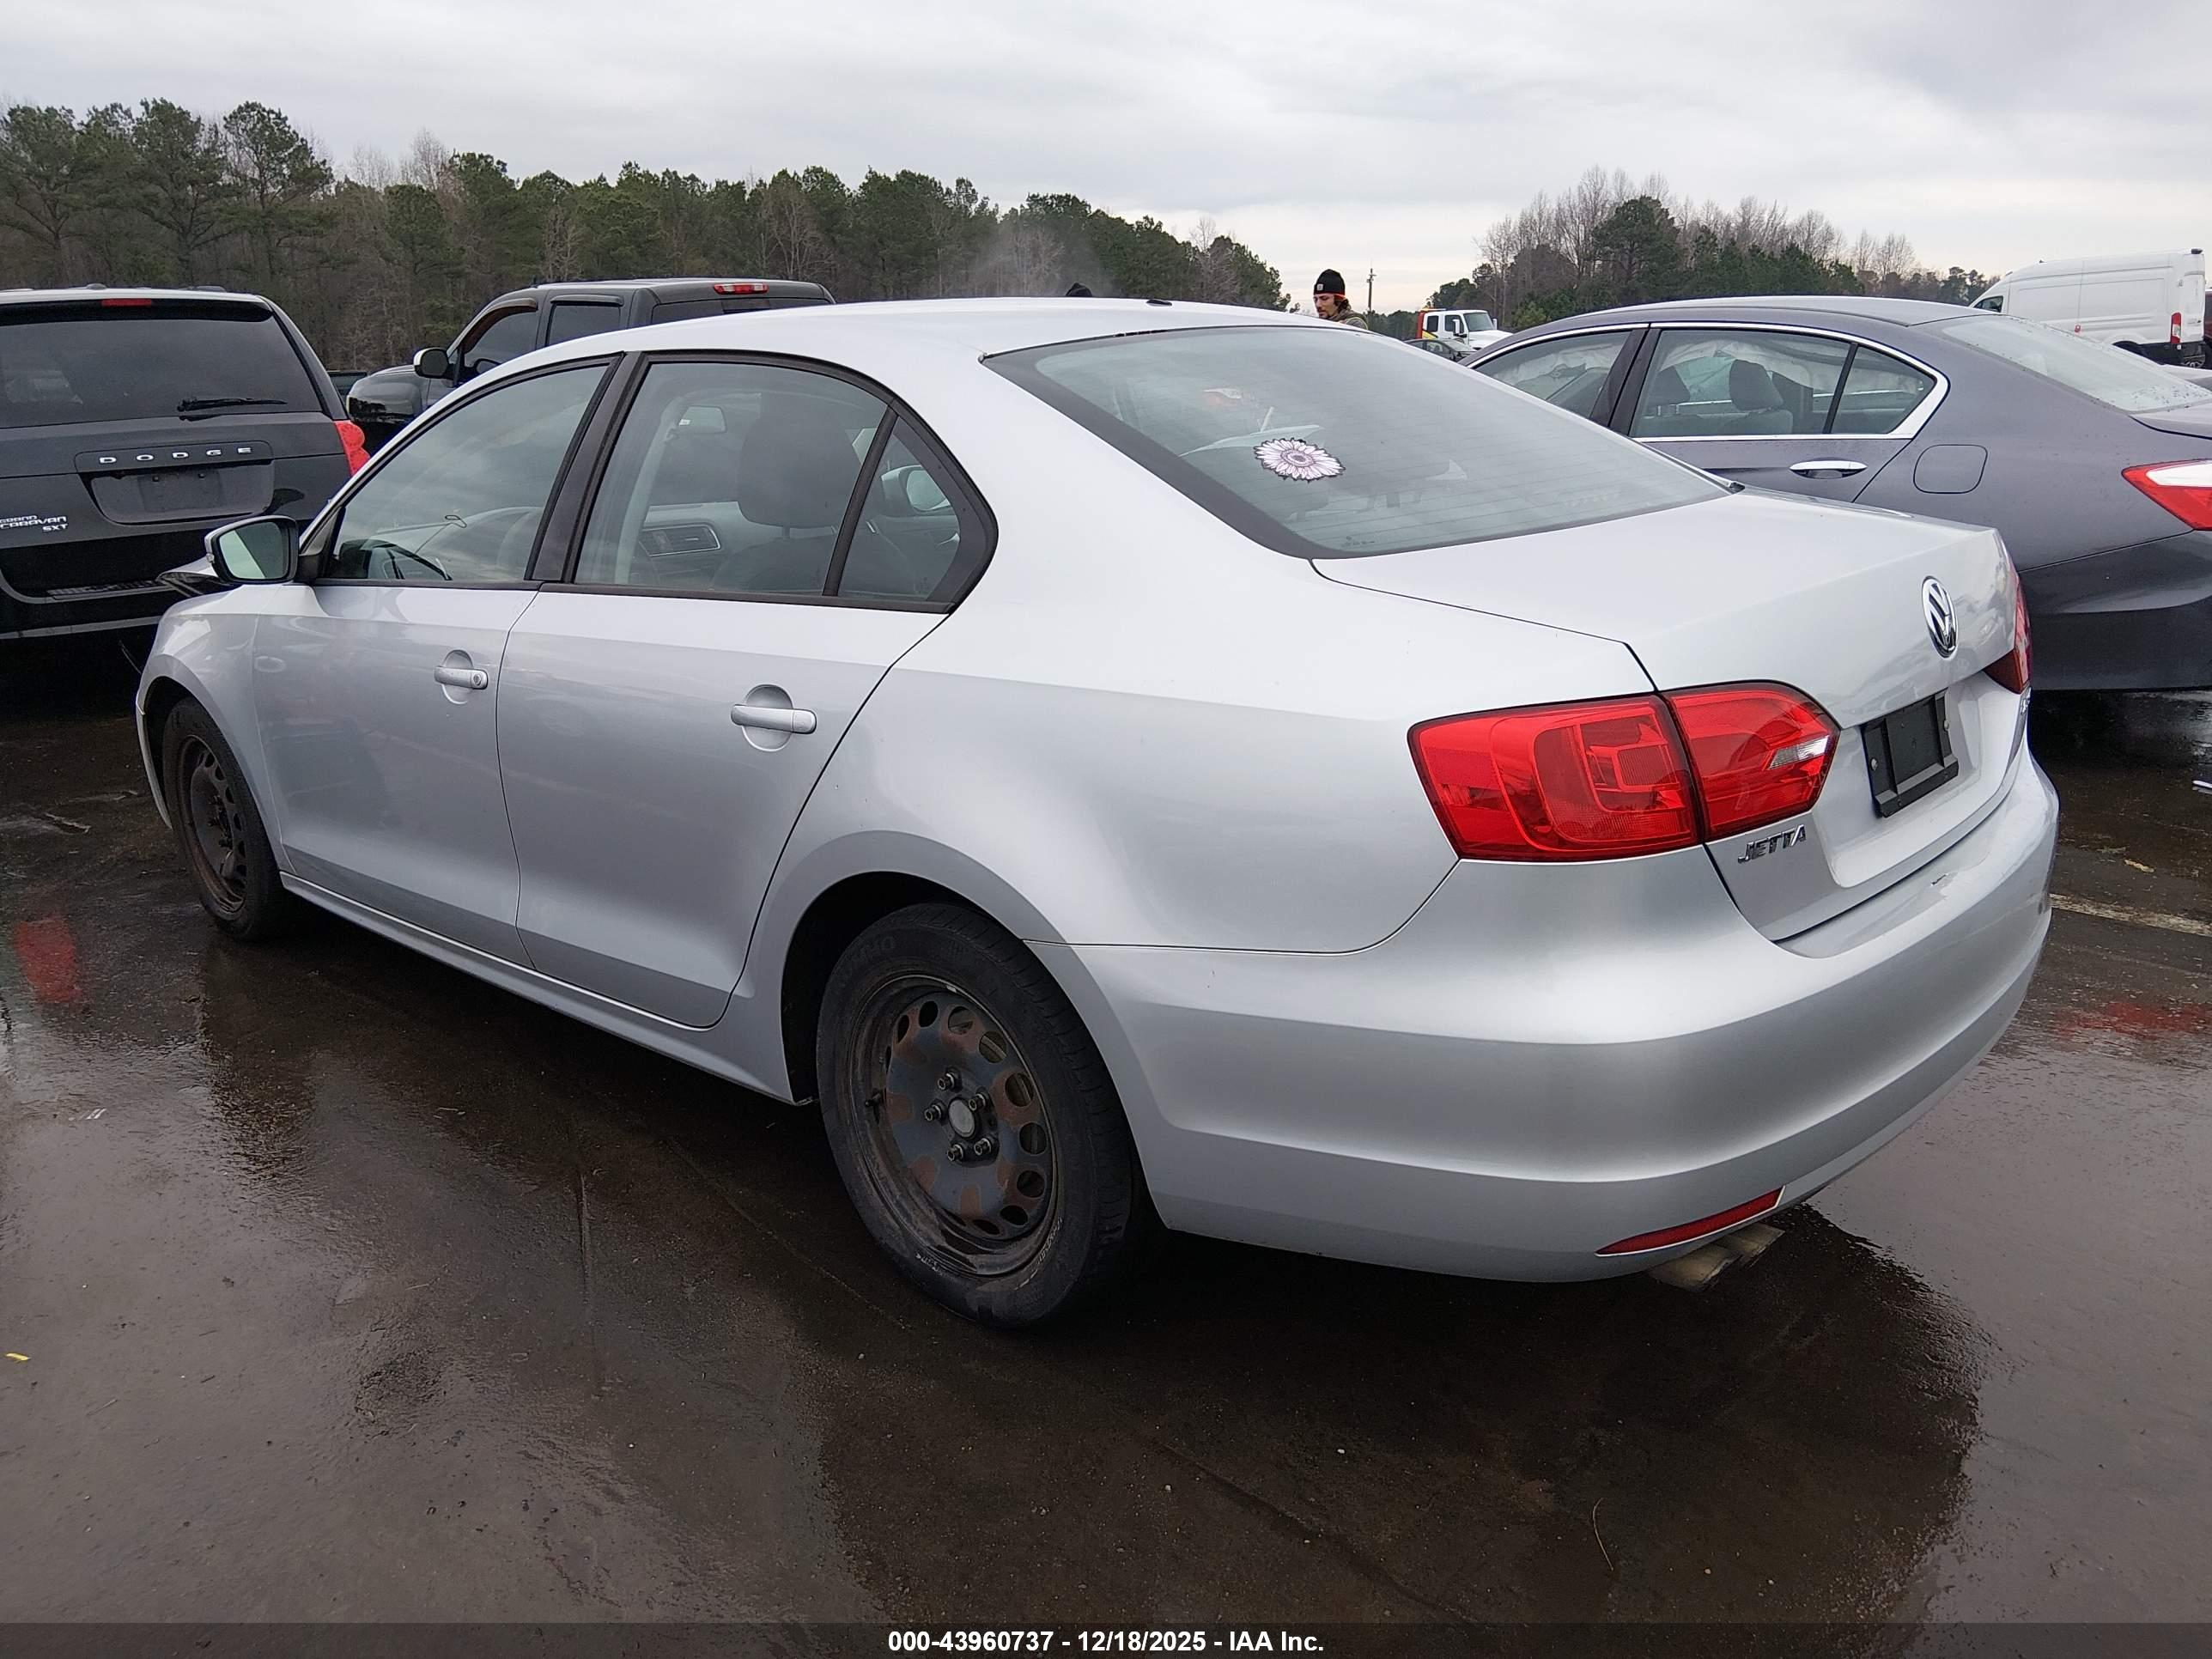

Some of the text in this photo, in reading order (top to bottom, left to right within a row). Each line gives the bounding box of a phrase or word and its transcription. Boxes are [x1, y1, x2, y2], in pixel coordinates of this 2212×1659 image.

[99, 447, 252, 464] DODGE
[0, 516, 67, 529] CARAVAN
[42, 523, 68, 532] SXT
[1737, 824, 1807, 864] JETTA
